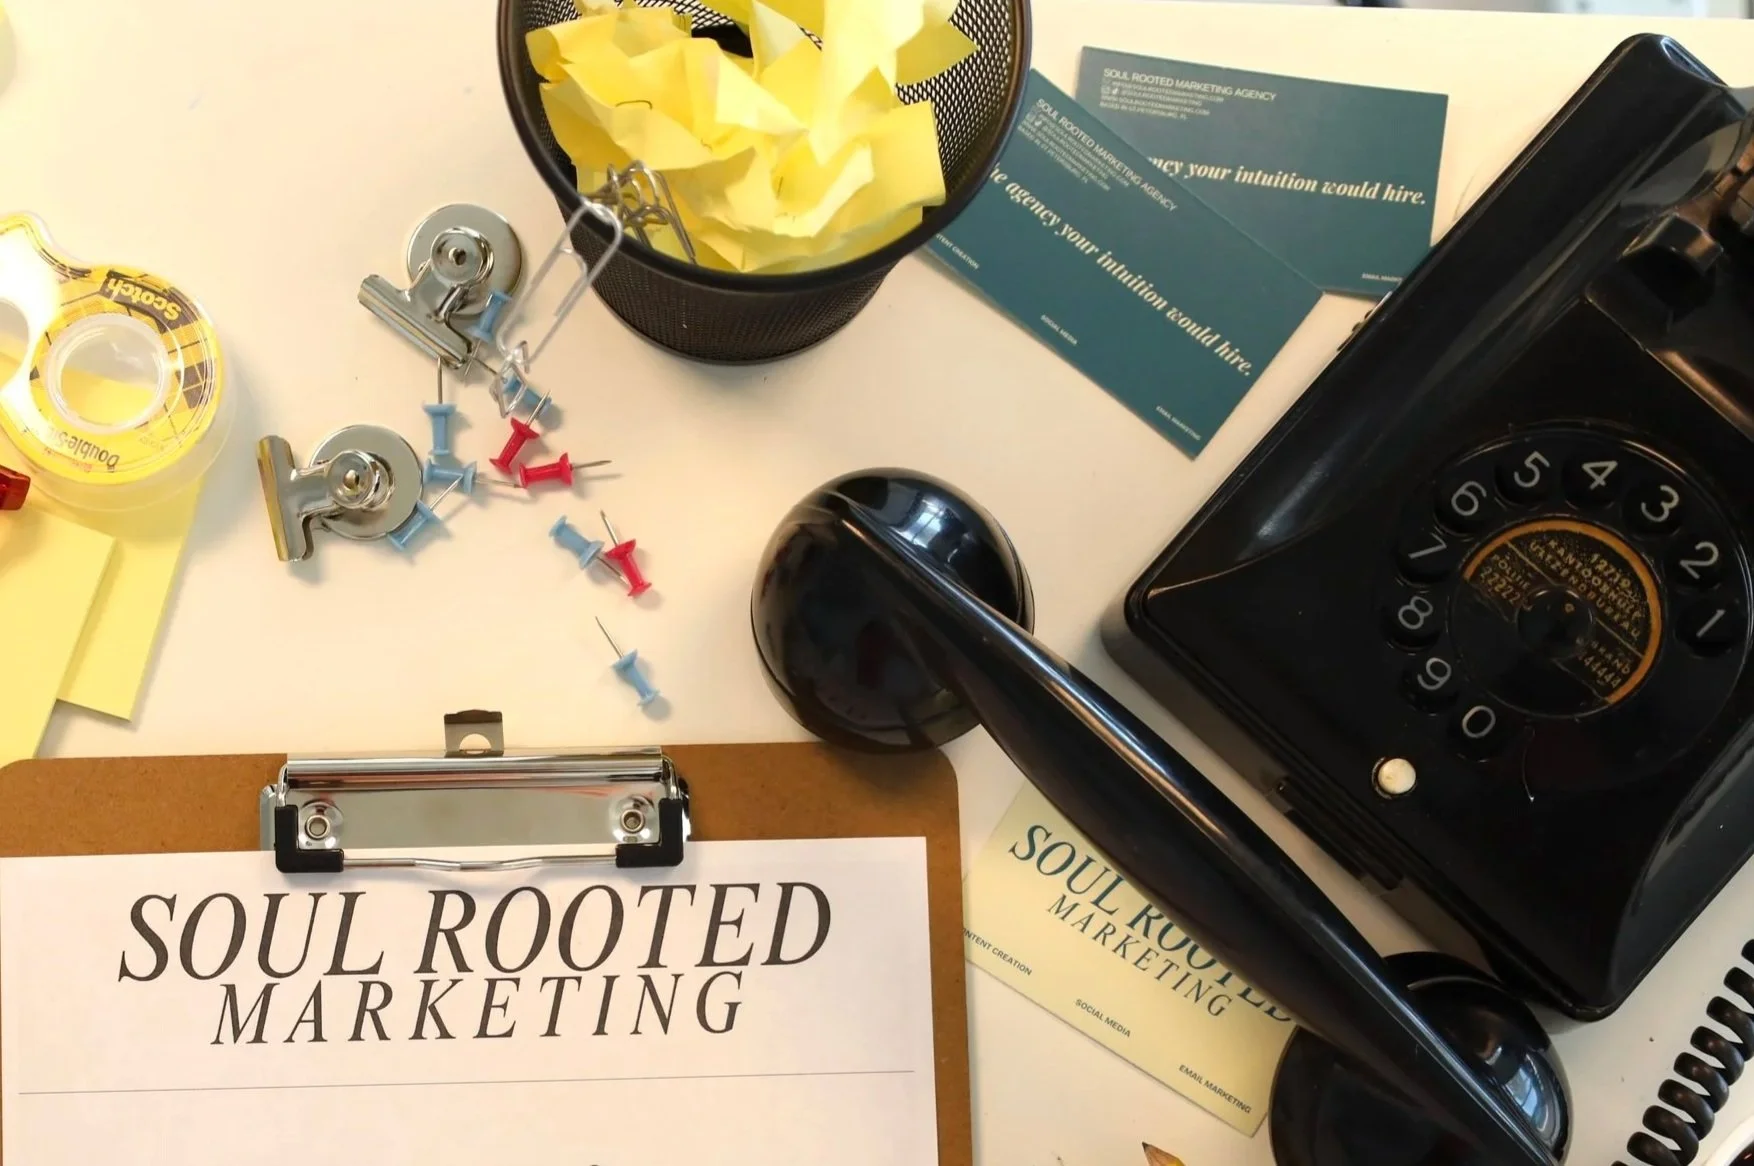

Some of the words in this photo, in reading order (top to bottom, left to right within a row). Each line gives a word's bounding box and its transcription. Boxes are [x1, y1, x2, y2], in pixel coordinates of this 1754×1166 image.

[1104, 68, 1129, 80] SOUL
[1132, 73, 1173, 86] ROOTED
[1176, 80, 1232, 95] MARKETING
[1234, 88, 1276, 100] AGENCY
[1037, 99, 1058, 120] SOUL
[1059, 117, 1094, 147] ROOTED
[1094, 144, 1140, 184] MARKETING
[1141, 183, 1176, 210] AGENCY
[1184, 164, 1231, 179] your
[1235, 166, 1317, 191] intuition
[1322, 182, 1380, 198] would
[1383, 184, 1425, 204] hire.
[1006, 183, 1060, 226] agency
[1055, 224, 1098, 254] your
[1097, 252, 1167, 310] intuition
[1166, 308, 1220, 346] would
[1215, 342, 1251, 375] hire.
[107, 277, 182, 321] Scotch
[1514, 451, 1550, 488] 5
[1582, 460, 1618, 490] 4
[1452, 481, 1487, 516] 6
[1641, 485, 1680, 522] 3
[1409, 533, 1448, 560] 7
[1680, 542, 1719, 579] 2
[1398, 596, 1434, 630] 8
[1697, 609, 1725, 637] 1
[1417, 656, 1453, 691] 9
[1462, 704, 1497, 739] 0
[1009, 825, 1127, 916] SOUL
[118, 892, 383, 981] SOUL
[414, 883, 830, 973] ROOTED
[992, 948, 1032, 975] CREATION
[1048, 894, 1234, 1016] MARKETING
[211, 971, 742, 1044] MARKETING
[1076, 999, 1103, 1020] SOCIAL
[1105, 1018, 1130, 1037] MEDIA
[1180, 1065, 1202, 1084] EMAIL
[1205, 1081, 1252, 1114] MARKETING
